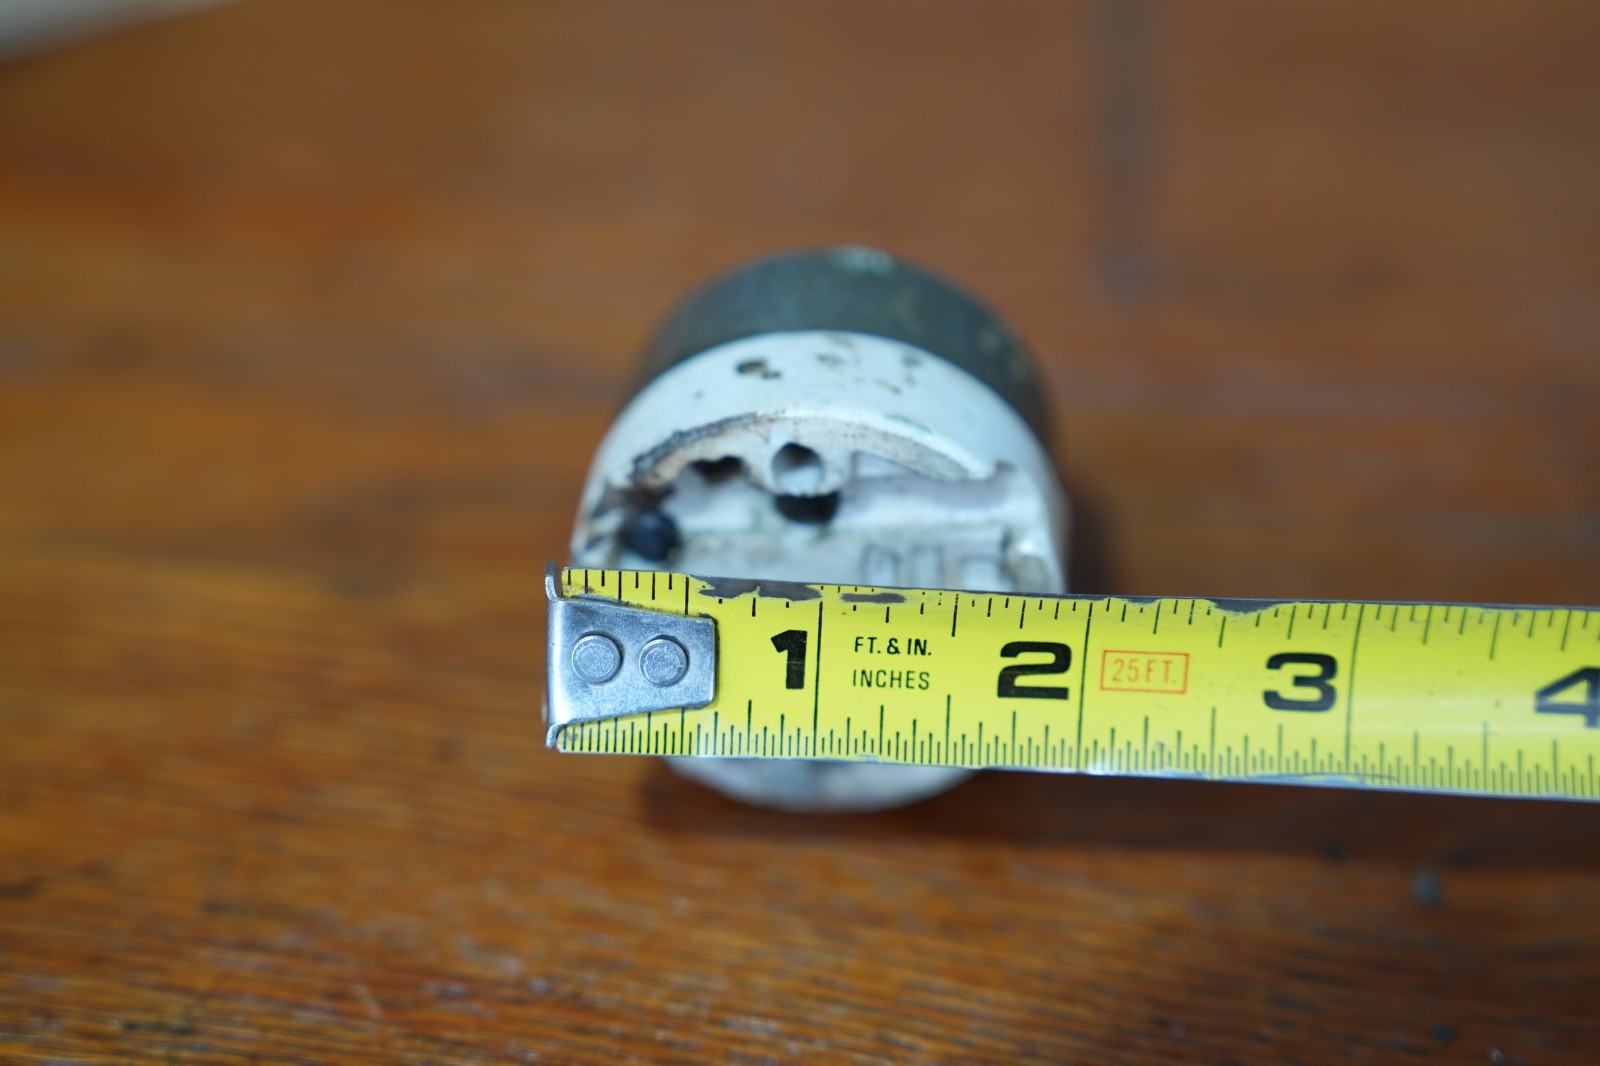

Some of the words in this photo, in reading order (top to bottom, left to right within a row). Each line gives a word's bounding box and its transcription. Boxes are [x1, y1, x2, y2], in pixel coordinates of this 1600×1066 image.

[770, 630, 807, 690] 1
[886, 637, 901, 655] &
[907, 638, 932, 656] IN.
[997, 641, 1072, 700] 2
[852, 669, 930, 690] INCHES
[1263, 652, 1338, 713] 3
[1534, 666, 1600, 729] 4
